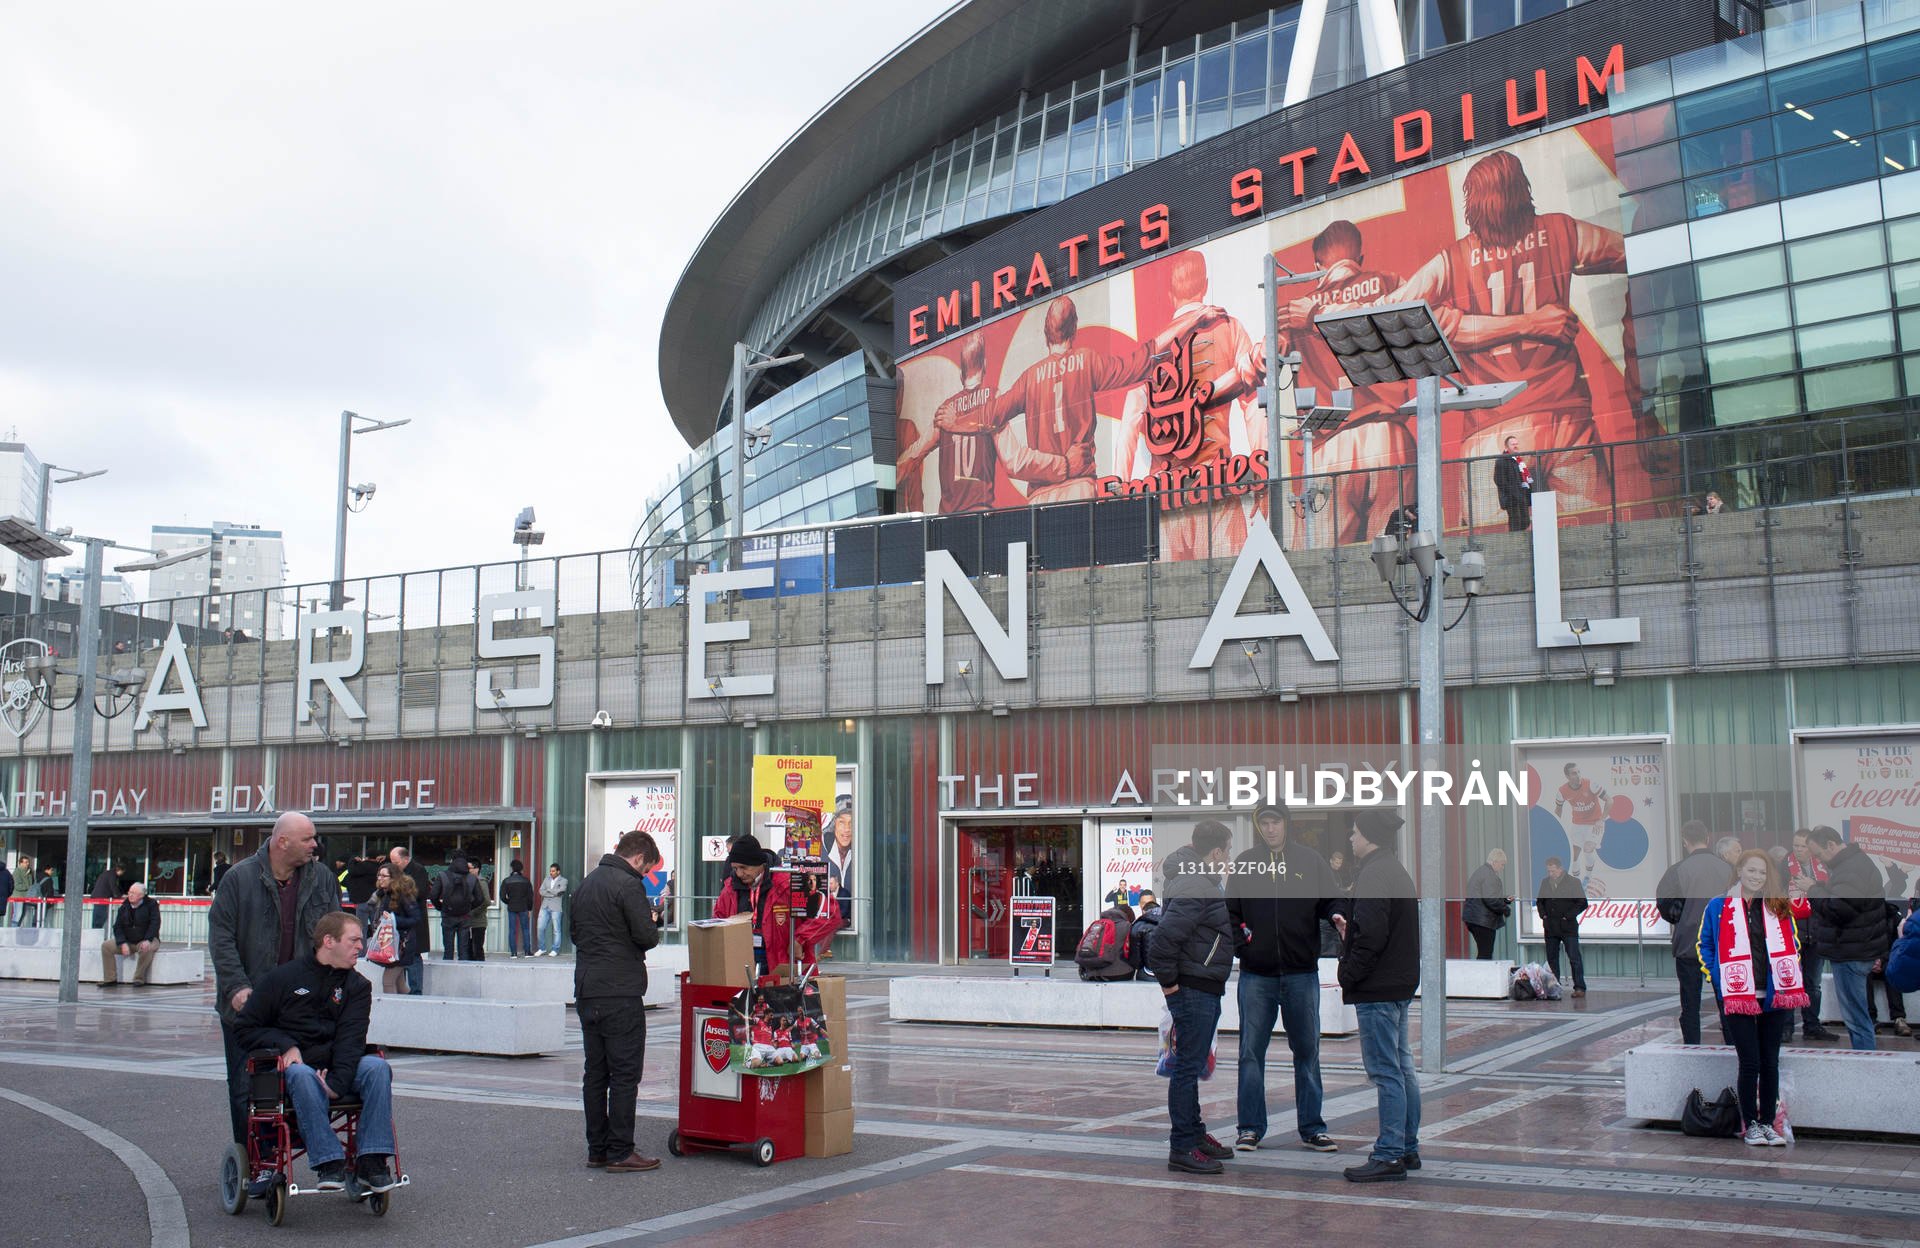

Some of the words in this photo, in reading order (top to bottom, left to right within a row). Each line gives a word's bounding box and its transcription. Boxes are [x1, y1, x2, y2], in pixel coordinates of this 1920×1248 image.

[909, 203, 1170, 346] EMIRATES
[1231, 43, 1626, 217] STADIUM
[1036, 353, 1085, 384] WILSON
[1053, 381, 1065, 434] 1
[1097, 447, 1269, 511] Emirates
[752, 535, 777, 550] THE
[133, 490, 1641, 731] ARSENAL
[1883, 745, 1912, 756] THE
[777, 759, 812, 769] Official
[1634, 754, 1660, 764] THE
[1857, 756, 1912, 767] SEASON
[1611, 764, 1660, 775] SEASON
[1858, 769, 1877, 780] TO
[1895, 768, 1914, 779] BE
[1612, 776, 1629, 786] TO
[1643, 776, 1661, 786] BE
[211, 785, 275, 813] BOX
[311, 779, 436, 812] OFFICE
[938, 772, 1039, 808] THE
[764, 797, 824, 808] Programme
[1859, 823, 1888, 834] Winter
[1106, 857, 1164, 878] inspired
[1578, 897, 1662, 928] playing
[706, 1024, 730, 1037] Arsena
